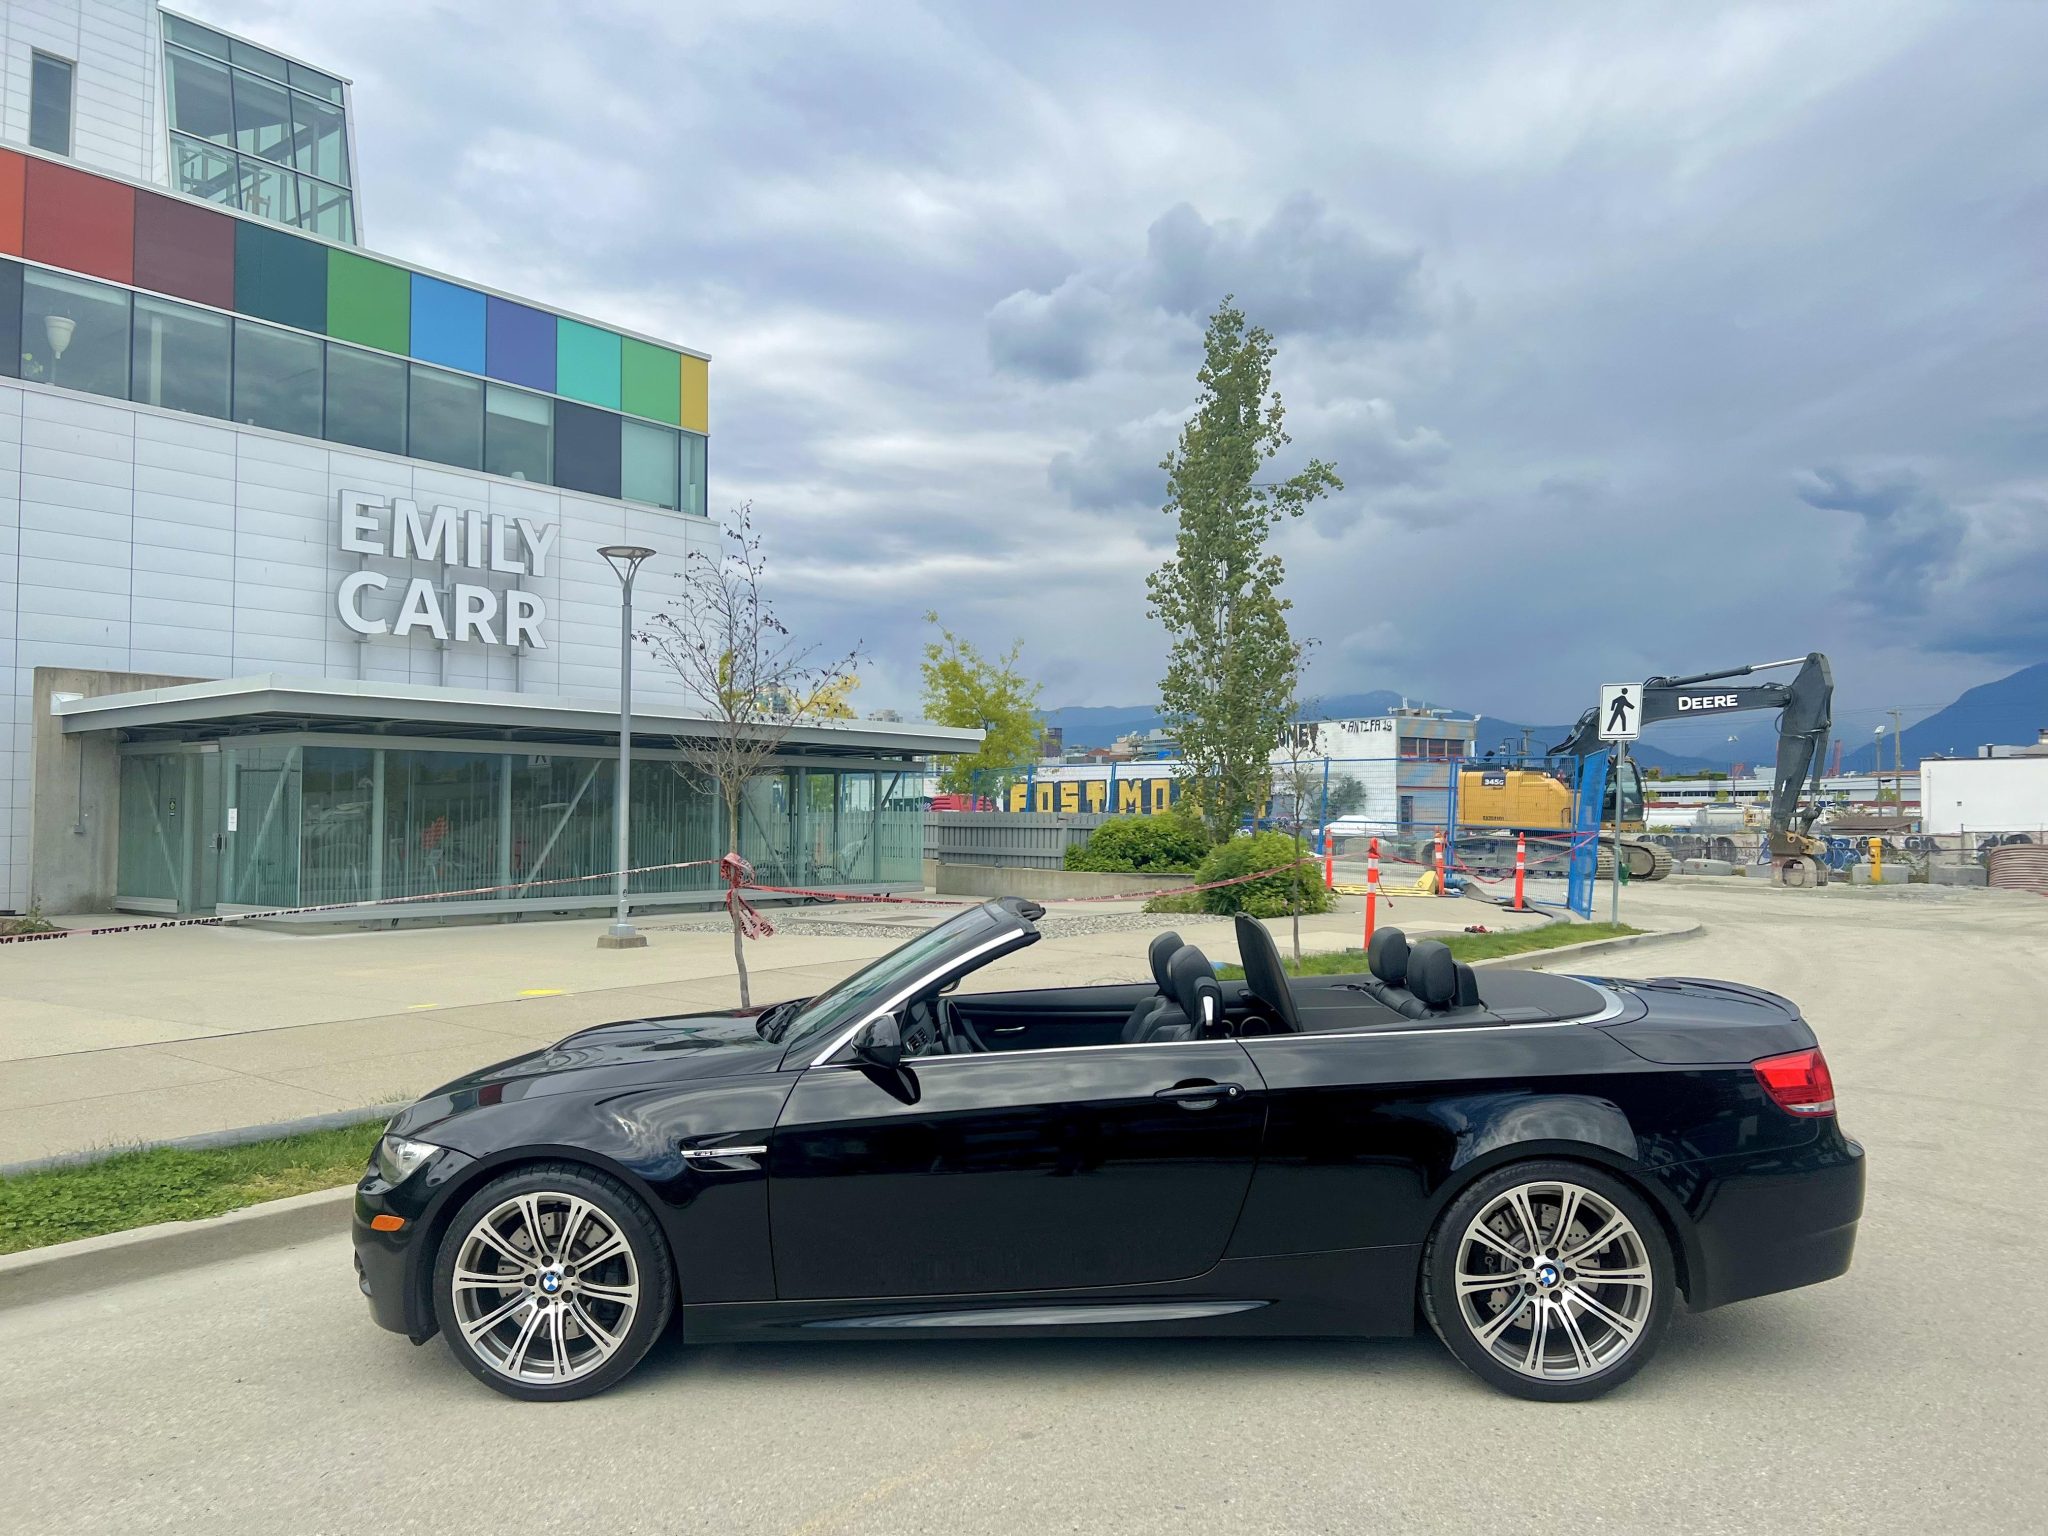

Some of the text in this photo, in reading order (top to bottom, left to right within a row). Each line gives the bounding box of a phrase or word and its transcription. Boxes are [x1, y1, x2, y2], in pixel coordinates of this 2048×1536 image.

[338, 488, 560, 577] EMILY
[336, 570, 547, 649] CARR
[1347, 719, 1381, 734] ANTIFA
[1678, 694, 1738, 711] DEERE
